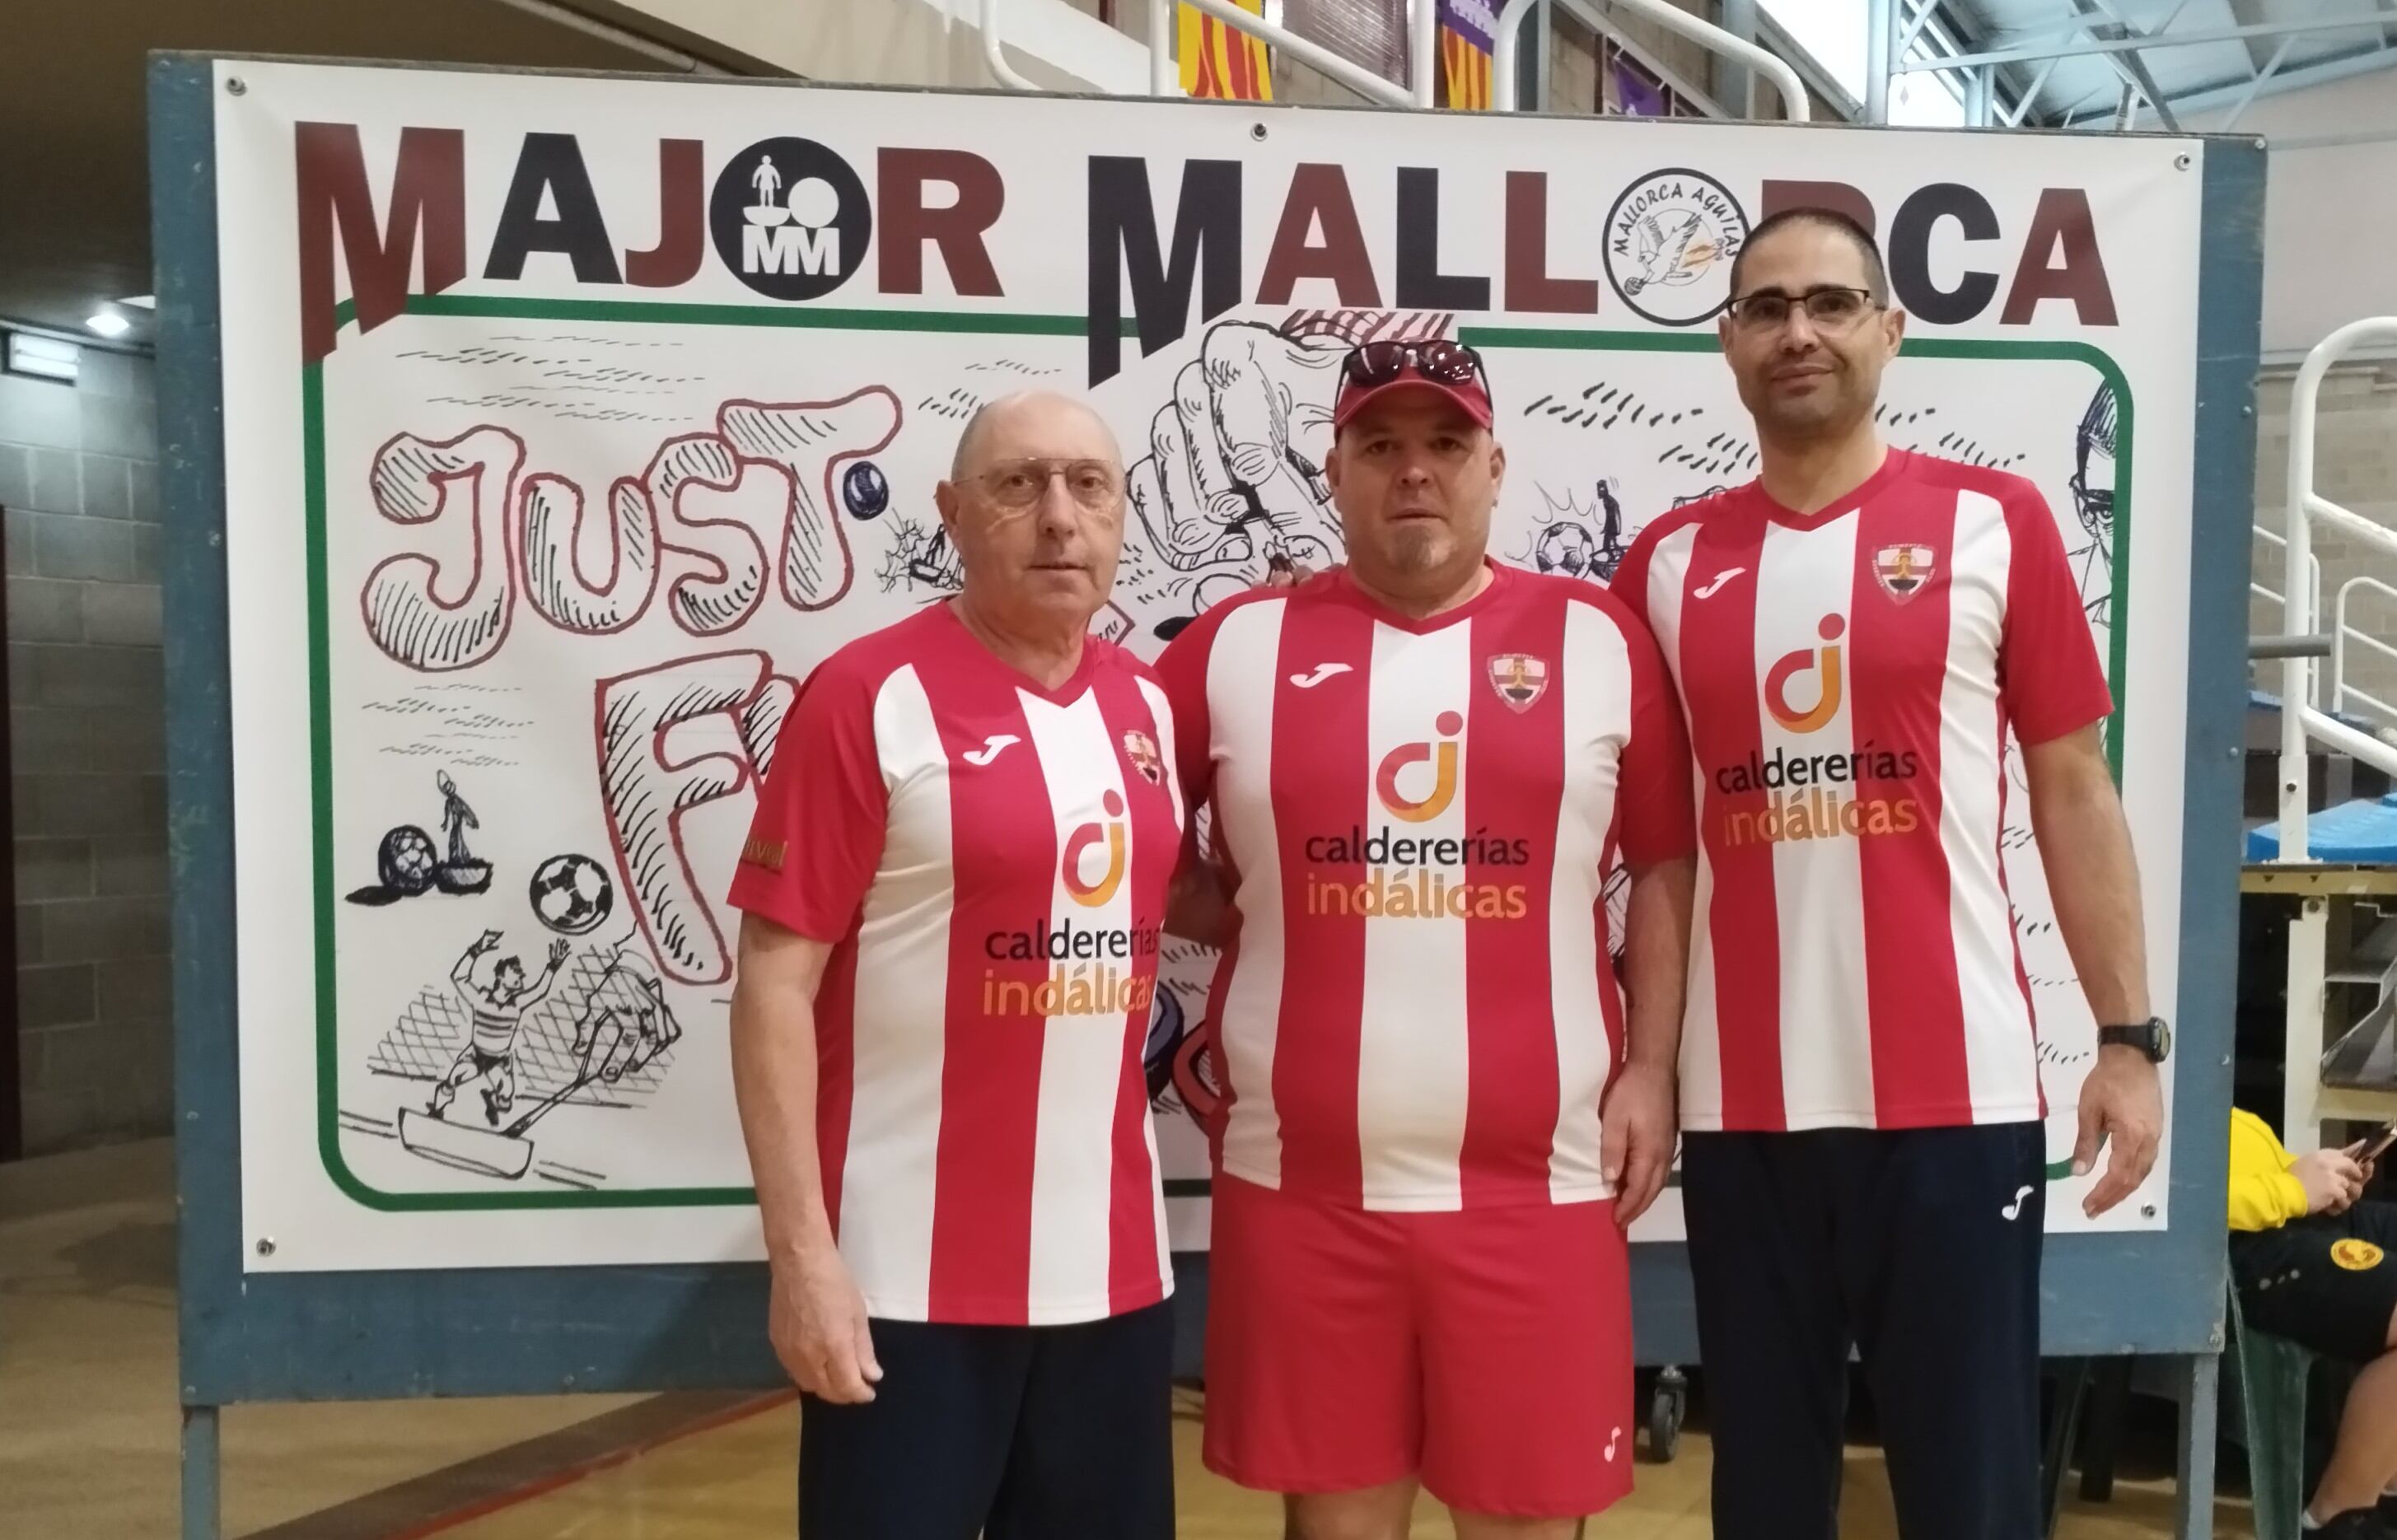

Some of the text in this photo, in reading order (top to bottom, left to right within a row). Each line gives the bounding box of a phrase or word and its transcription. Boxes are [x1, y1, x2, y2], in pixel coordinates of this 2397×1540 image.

[295, 120, 1006, 366] MAJOR
[1614, 182, 1683, 257] MALLORCA
[742, 224, 840, 277] MM
[361, 384, 903, 673] JUST
[1716, 739, 1918, 794] caldererías
[1722, 787, 1918, 846] indálicas
[1305, 825, 1530, 866] caldererías
[1307, 867, 1527, 919] indálicas
